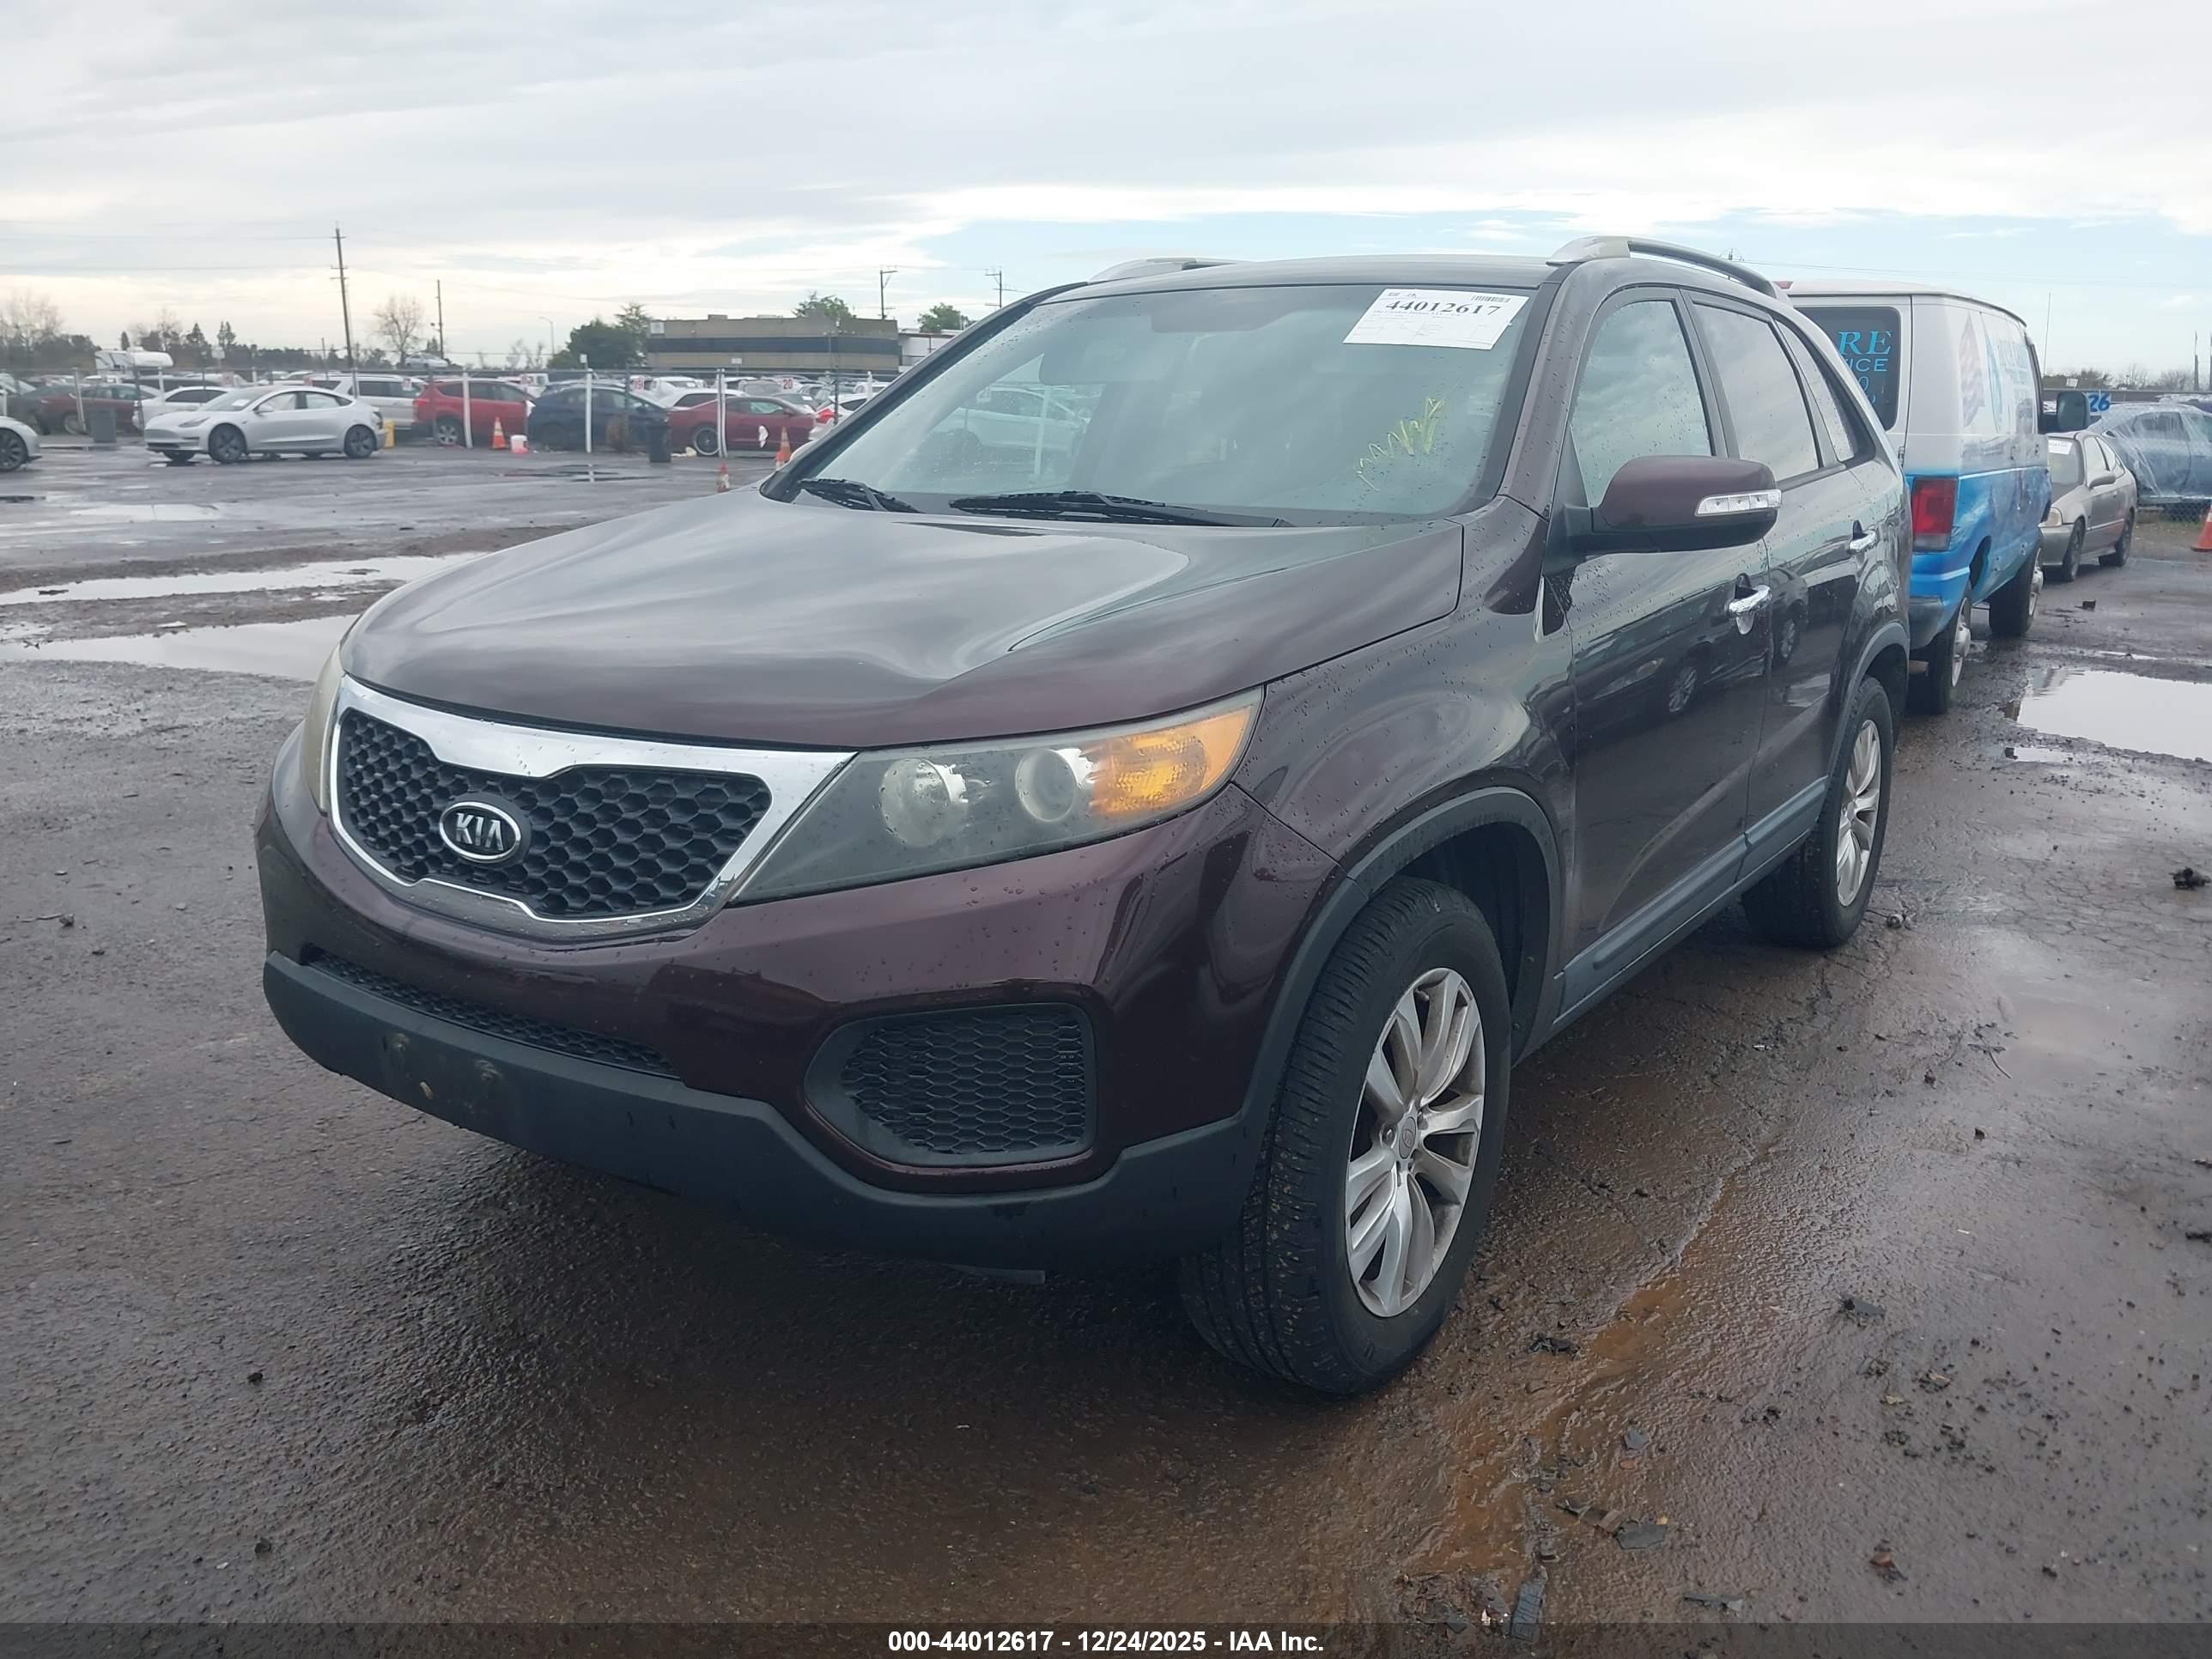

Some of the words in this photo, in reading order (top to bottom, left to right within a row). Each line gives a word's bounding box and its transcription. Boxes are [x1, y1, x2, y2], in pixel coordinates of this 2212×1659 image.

[1385, 301, 1501, 316] 44012617
[2087, 391, 2111, 413] 26
[456, 812, 504, 851] KIA
